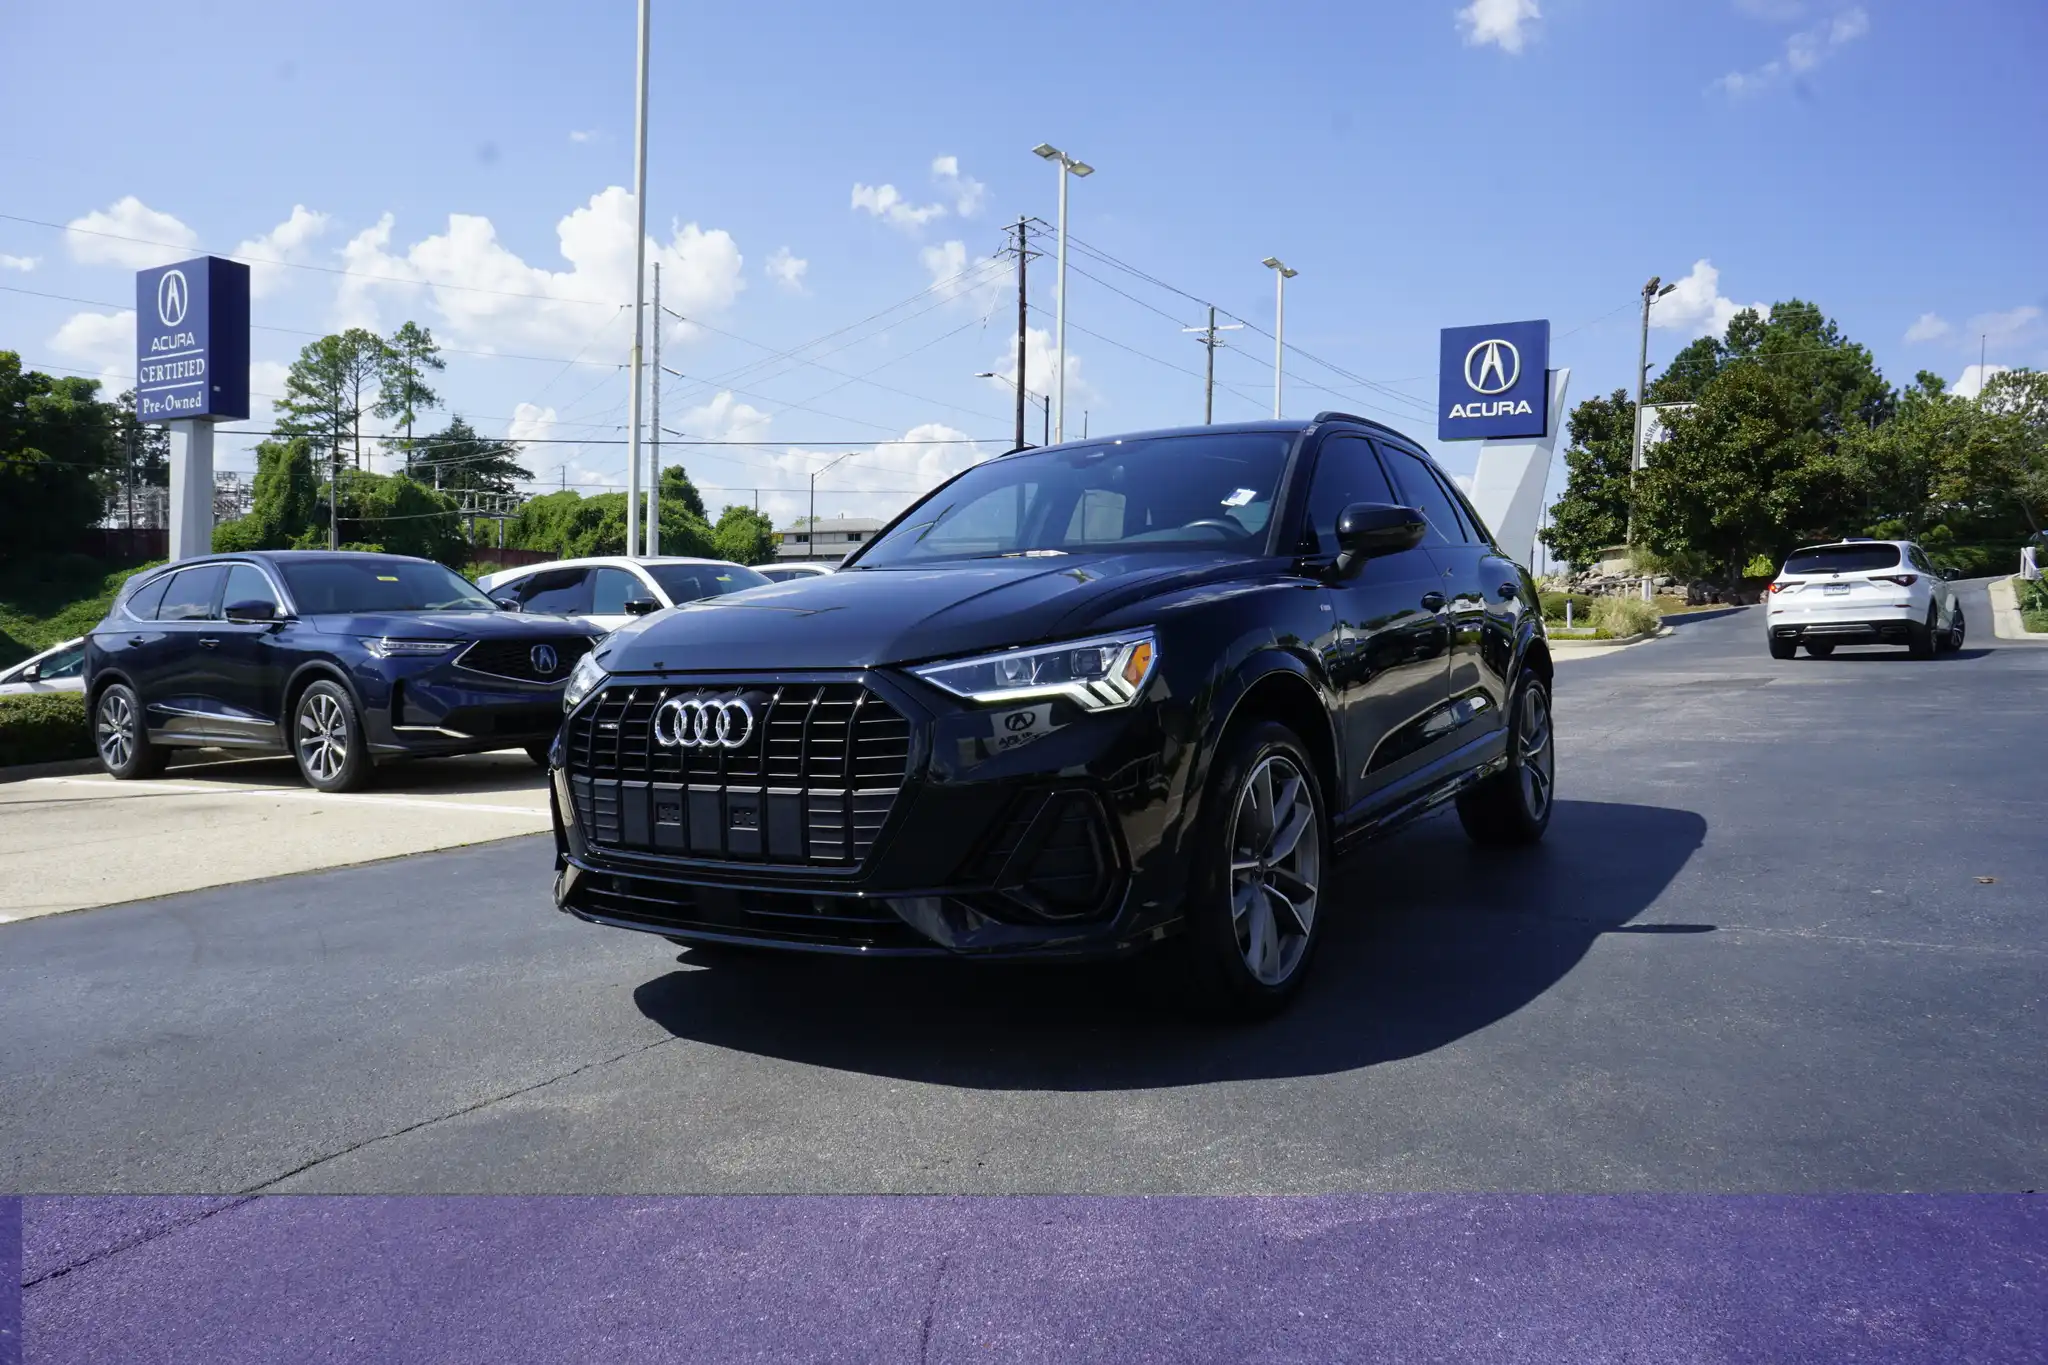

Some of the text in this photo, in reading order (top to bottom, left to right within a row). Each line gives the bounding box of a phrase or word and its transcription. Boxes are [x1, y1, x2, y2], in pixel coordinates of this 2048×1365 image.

[151, 331, 195, 352] ACURA
[140, 358, 205, 383] CERTIFIED
[143, 391, 202, 414] Pre-Owned
[1448, 400, 1532, 419] ACURA
